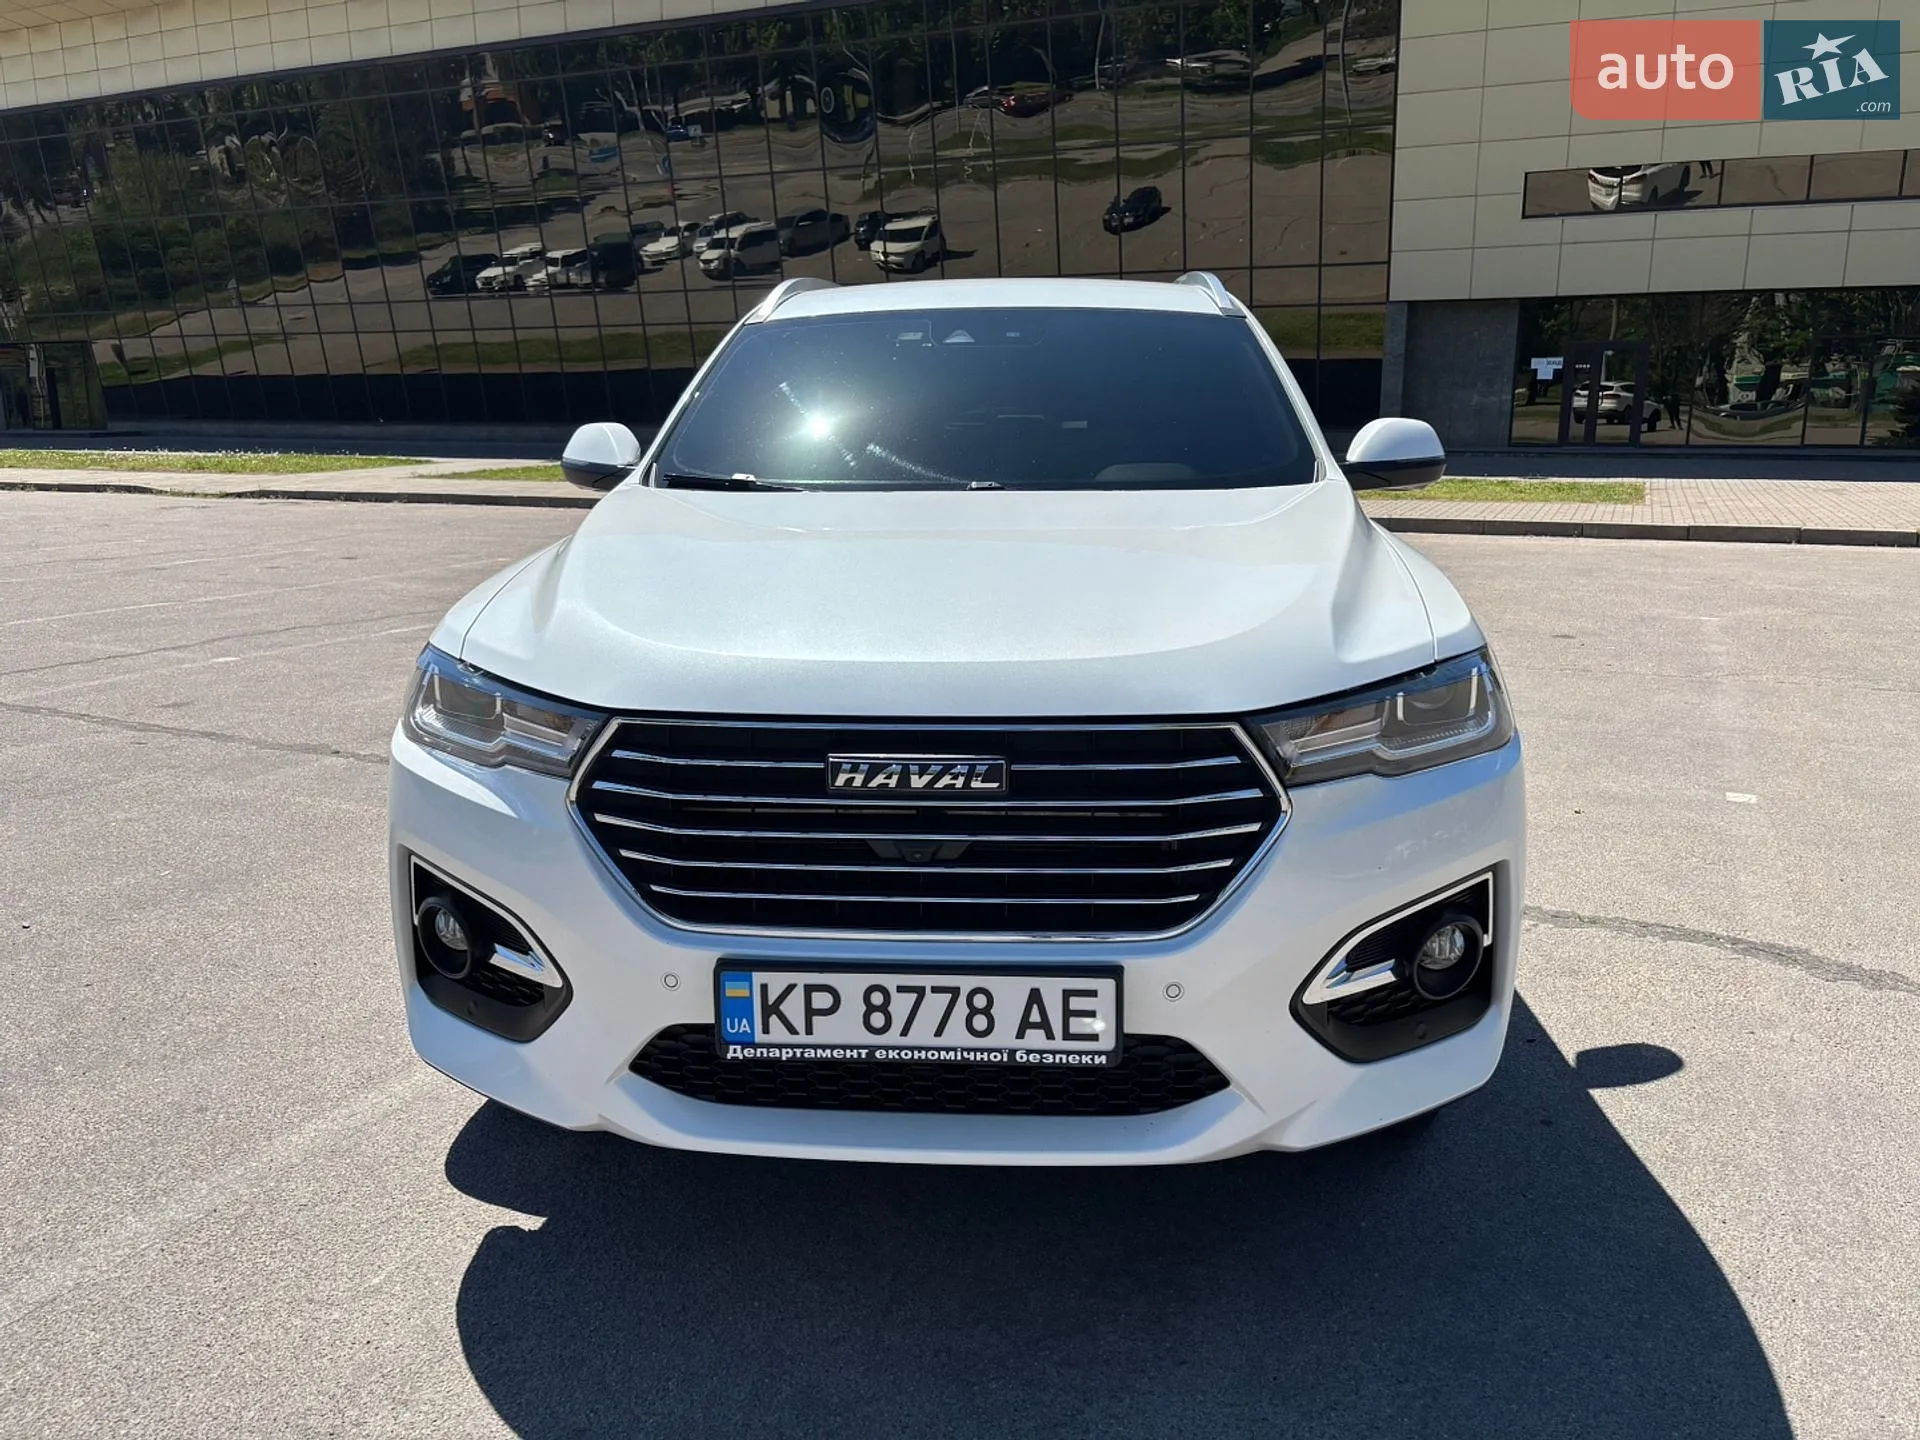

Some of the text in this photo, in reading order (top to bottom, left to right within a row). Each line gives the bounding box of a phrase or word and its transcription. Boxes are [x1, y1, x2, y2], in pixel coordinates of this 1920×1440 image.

[834, 763, 1000, 788] HAVAL
[759, 982, 1100, 1042] KP 8778 AE
[726, 1016, 751, 1034] UA
[726, 1044, 1107, 1065] Департамент економічної безпеки
